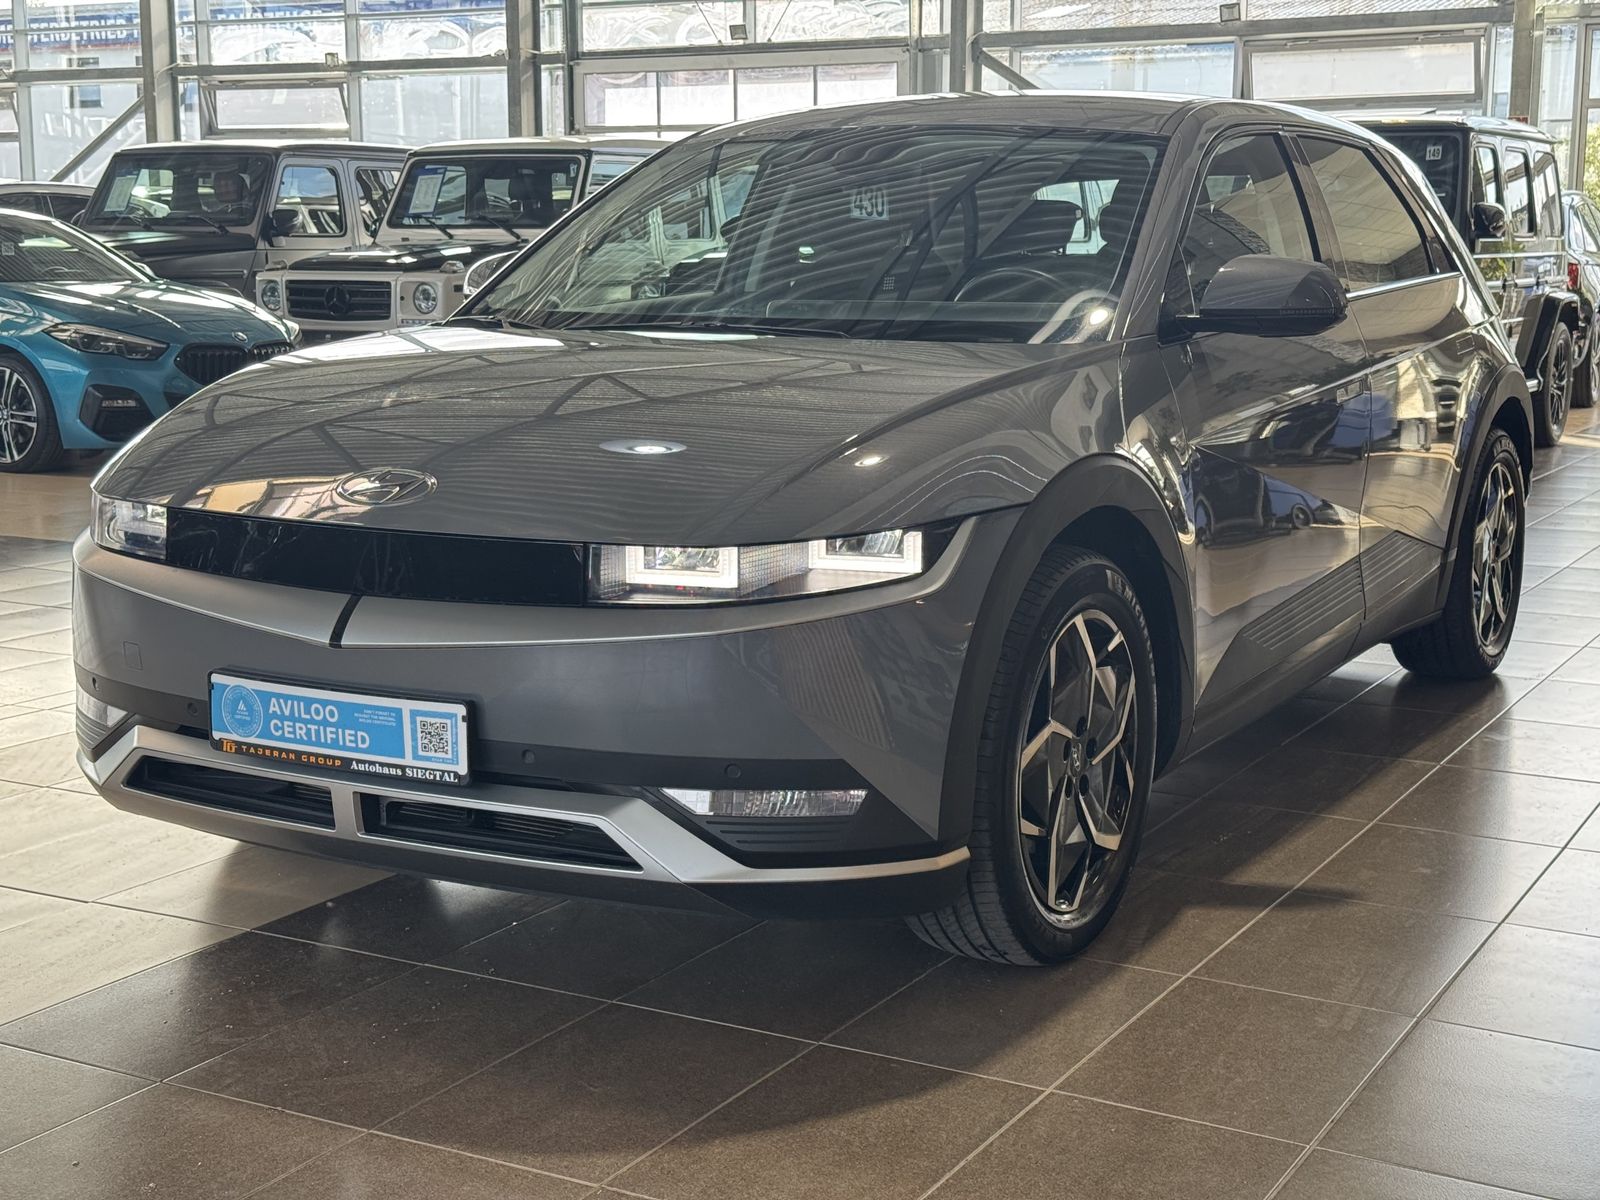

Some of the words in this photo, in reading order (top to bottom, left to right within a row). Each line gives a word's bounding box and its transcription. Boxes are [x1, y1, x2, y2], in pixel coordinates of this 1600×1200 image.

[853, 188, 885, 217] 430
[268, 697, 339, 722] AVILOO
[270, 719, 370, 748] CERTIFIED
[241, 745, 295, 760] TAJERAN
[301, 754, 342, 767] GROUP
[350, 760, 402, 776] Autohaus
[405, 767, 458, 783] SIEGTAL
